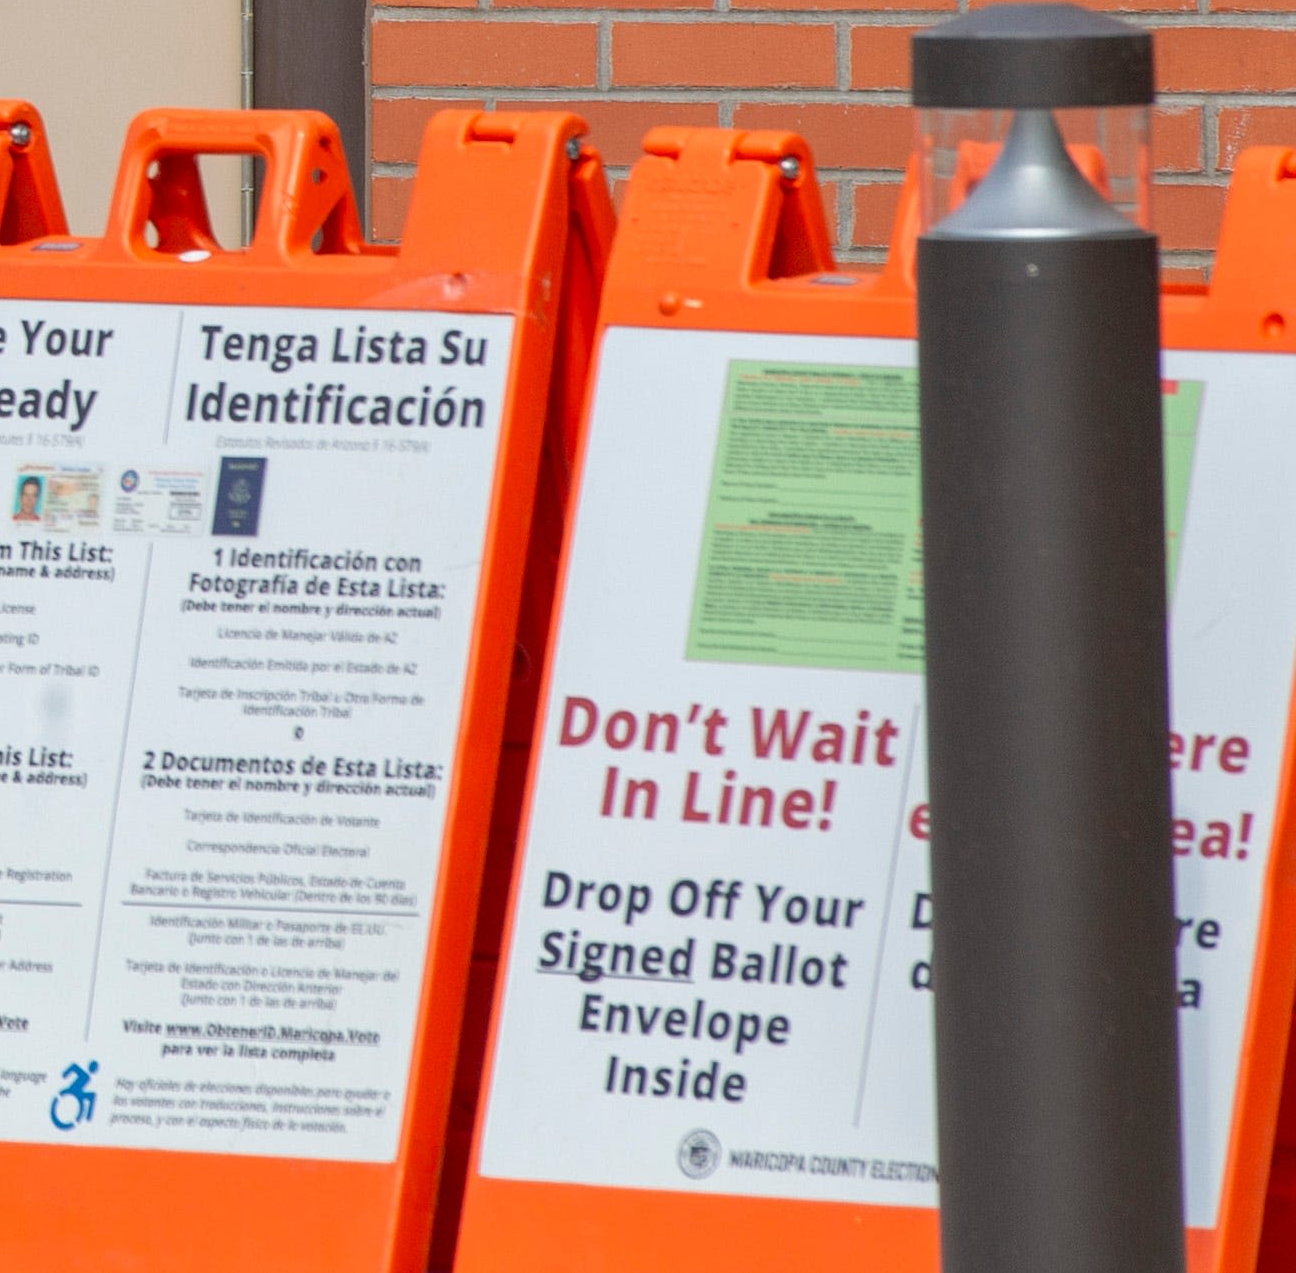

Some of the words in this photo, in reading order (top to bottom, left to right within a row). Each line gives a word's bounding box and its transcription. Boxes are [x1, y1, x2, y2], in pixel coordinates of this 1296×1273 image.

[21, 319, 114, 357] Your
[201, 325, 319, 374] Tenga
[331, 325, 428, 365] Lista
[439, 329, 488, 367] Su
[186, 381, 485, 428] Identificación
[19, 540, 62, 562] This
[68, 541, 113, 563] List:
[214, 547, 224, 567] 1
[230, 547, 378, 572] Identificación
[383, 556, 422, 573] con
[39, 564, 50, 579] &
[53, 565, 115, 582] address)
[189, 572, 299, 599] Fotografía
[304, 575, 331, 597] de
[336, 576, 381, 598] Esta
[387, 578, 446, 599] Lista:
[558, 695, 728, 757] Don't
[751, 707, 900, 768] Wait
[11, 770, 23, 784] &
[26, 771, 88, 787] address)
[28, 746, 73, 769] List:
[142, 750, 156, 771] 2
[161, 751, 296, 776] Documentos
[301, 755, 327, 777] de
[333, 757, 378, 778] Esta
[383, 758, 443, 781] Lista:
[600, 766, 659, 820] In
[681, 769, 838, 832] Line!
[542, 870, 652, 926] Drop
[669, 879, 743, 920] Off
[756, 884, 865, 929] Your
[538, 929, 696, 984] Signed
[710, 942, 848, 989] Ballot
[579, 993, 791, 1055] Envelope
[605, 1055, 747, 1103] Inside
